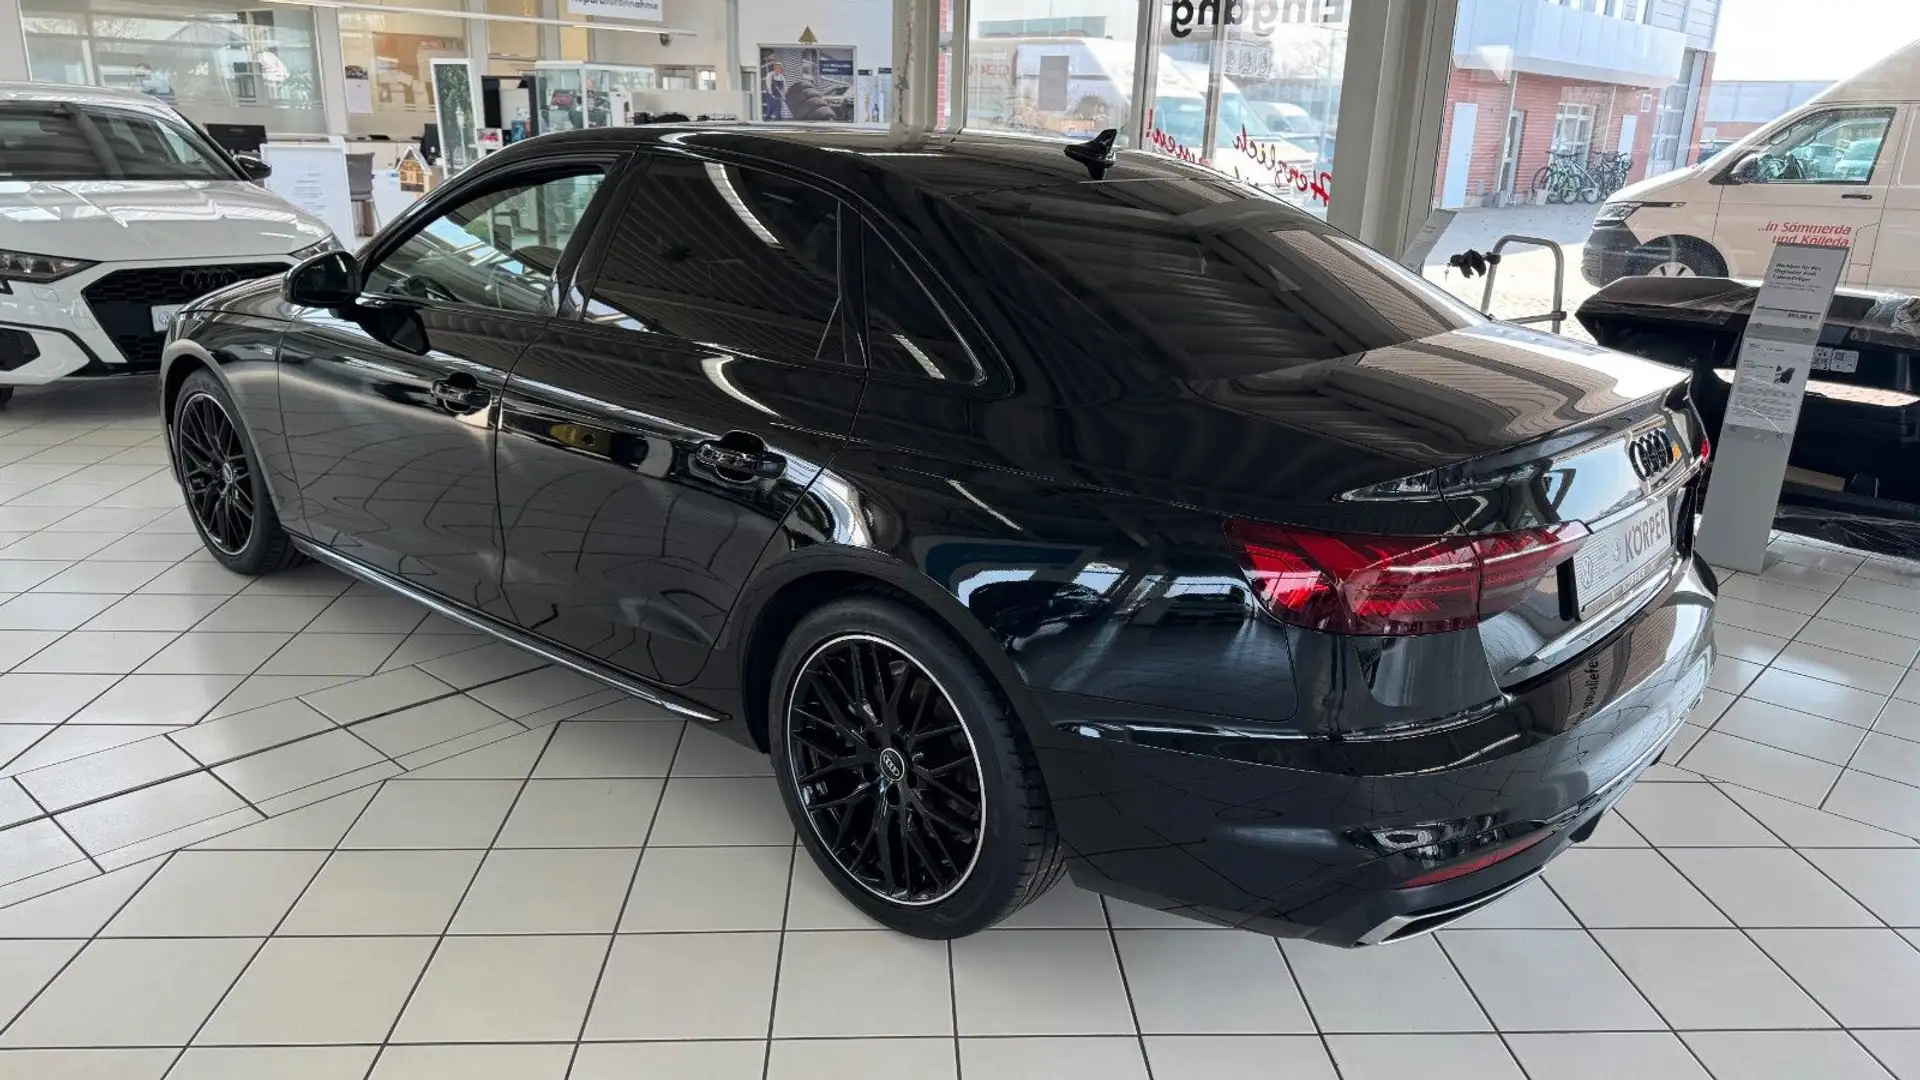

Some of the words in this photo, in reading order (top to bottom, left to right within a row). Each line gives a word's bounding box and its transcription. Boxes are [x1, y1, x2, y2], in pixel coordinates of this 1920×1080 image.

[1781, 221, 1851, 235] Sömmerda
[1802, 235, 1849, 247] Kölleda
[1624, 507, 1668, 563] KÖRPER
